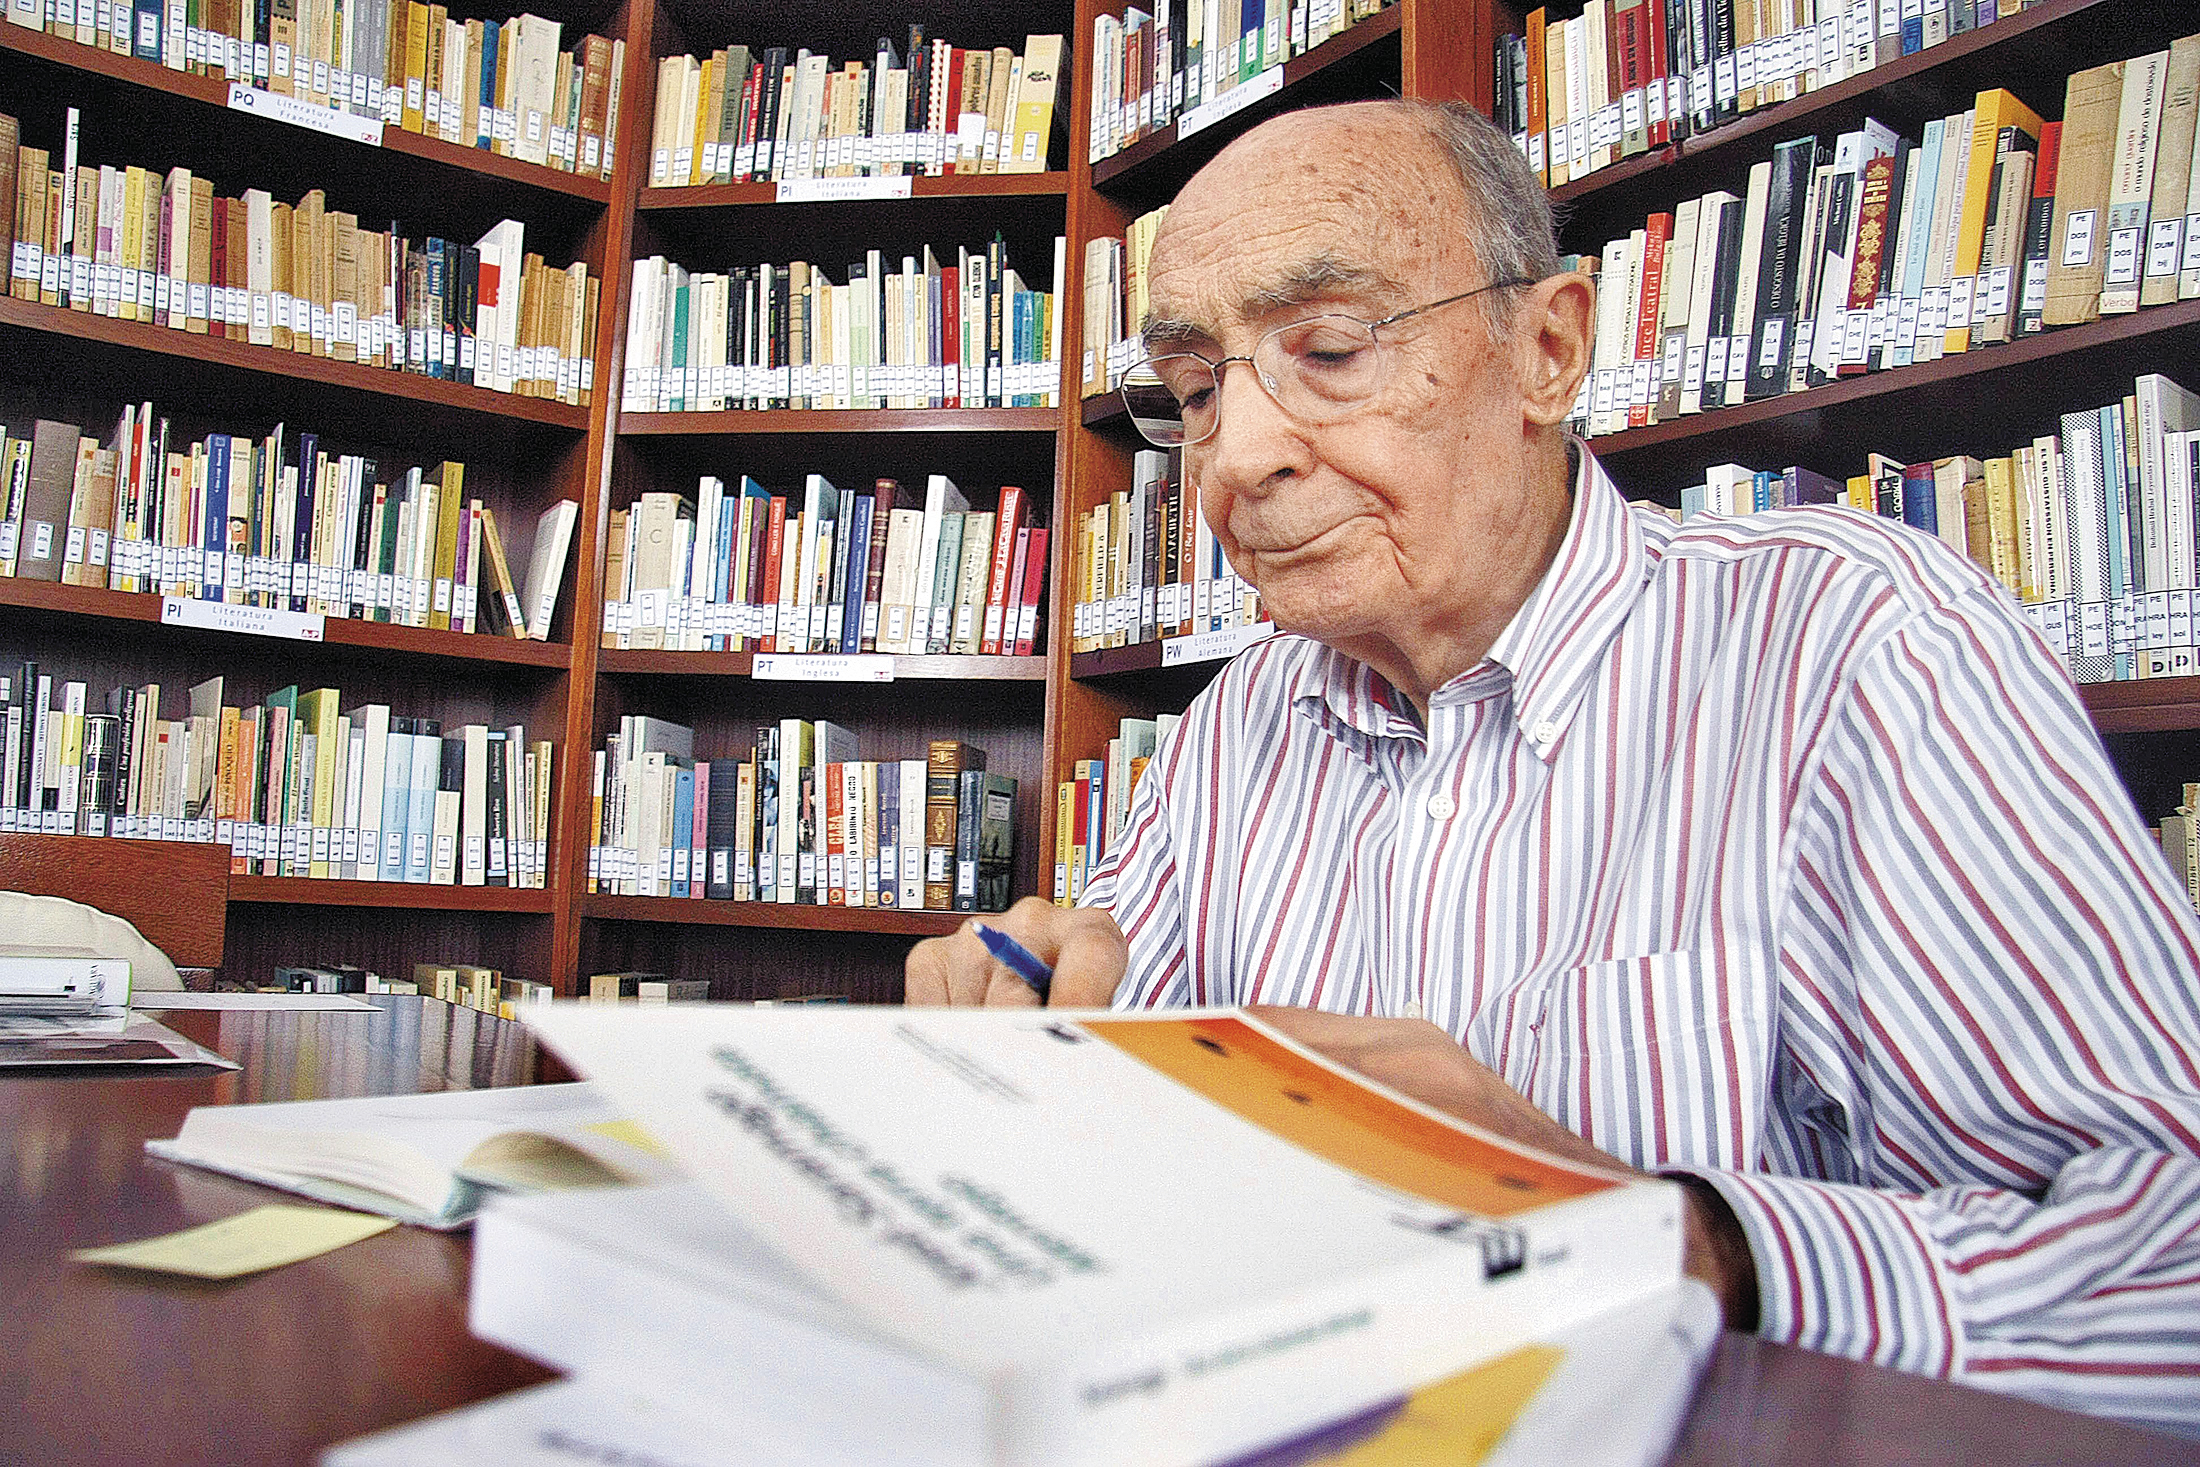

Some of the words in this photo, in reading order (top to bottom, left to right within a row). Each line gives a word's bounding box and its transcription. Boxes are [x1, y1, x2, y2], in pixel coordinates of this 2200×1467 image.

[233, 91, 254, 107] PQ
[1181, 117, 1192, 131] PT
[1166, 645, 1182, 659] PW
[757, 660, 774, 672] PT
